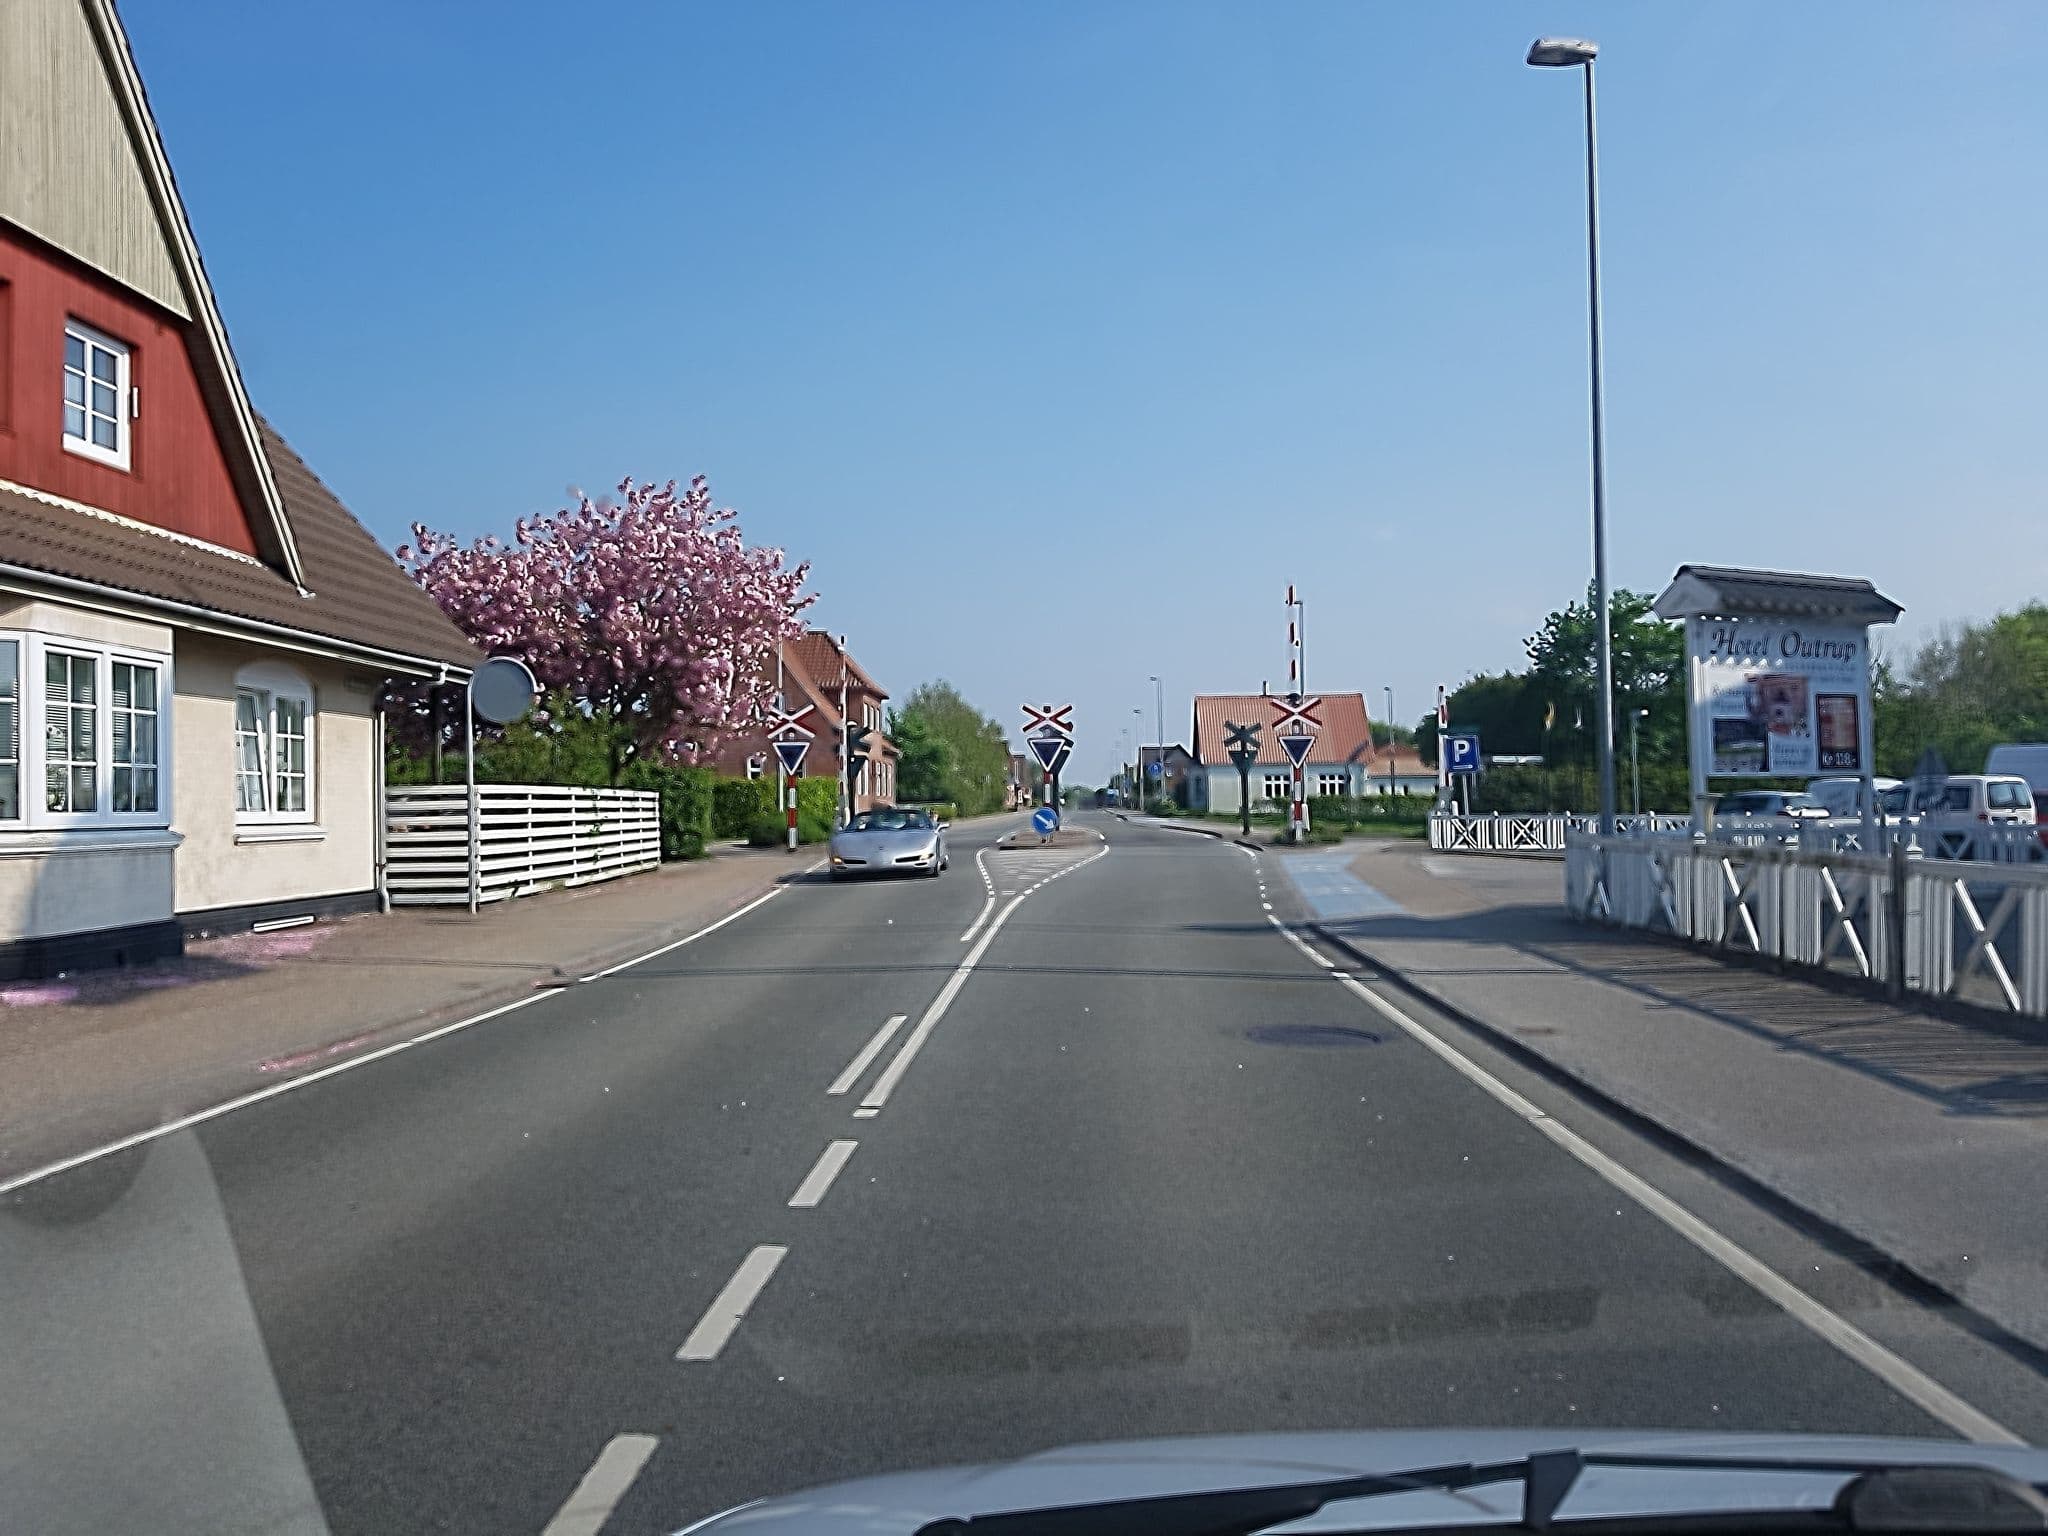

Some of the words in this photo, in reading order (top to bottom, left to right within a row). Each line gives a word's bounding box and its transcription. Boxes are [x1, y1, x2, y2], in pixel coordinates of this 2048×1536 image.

[1710, 625, 1769, 656] Hotel
[1781, 629, 1856, 663] Outrup
[1454, 740, 1470, 762] P
